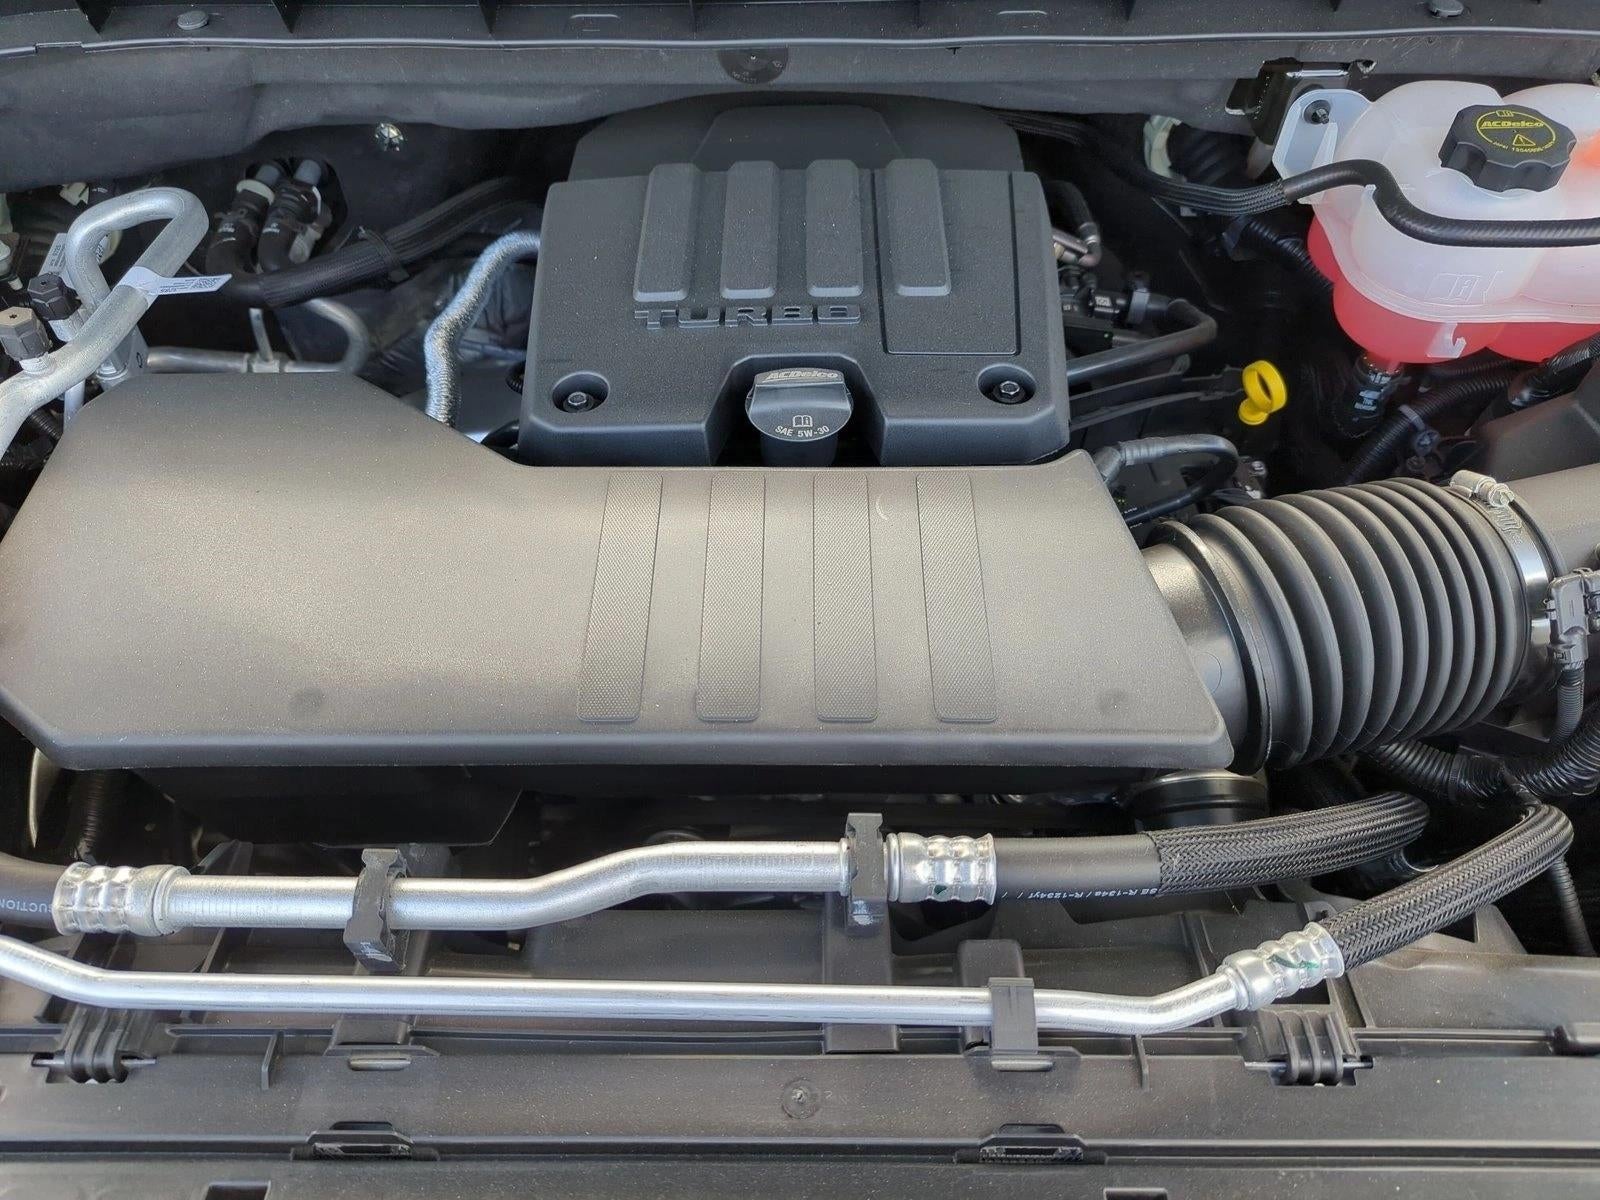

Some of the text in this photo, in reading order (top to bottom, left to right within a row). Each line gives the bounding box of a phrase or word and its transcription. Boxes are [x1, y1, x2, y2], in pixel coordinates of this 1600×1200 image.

[1480, 120, 1545, 130] ACDelco
[634, 304, 862, 329] TURBO
[765, 370, 839, 381] ACDelco
[774, 425, 830, 438] SAE 5W-30
[0, 898, 52, 913] UCTION
